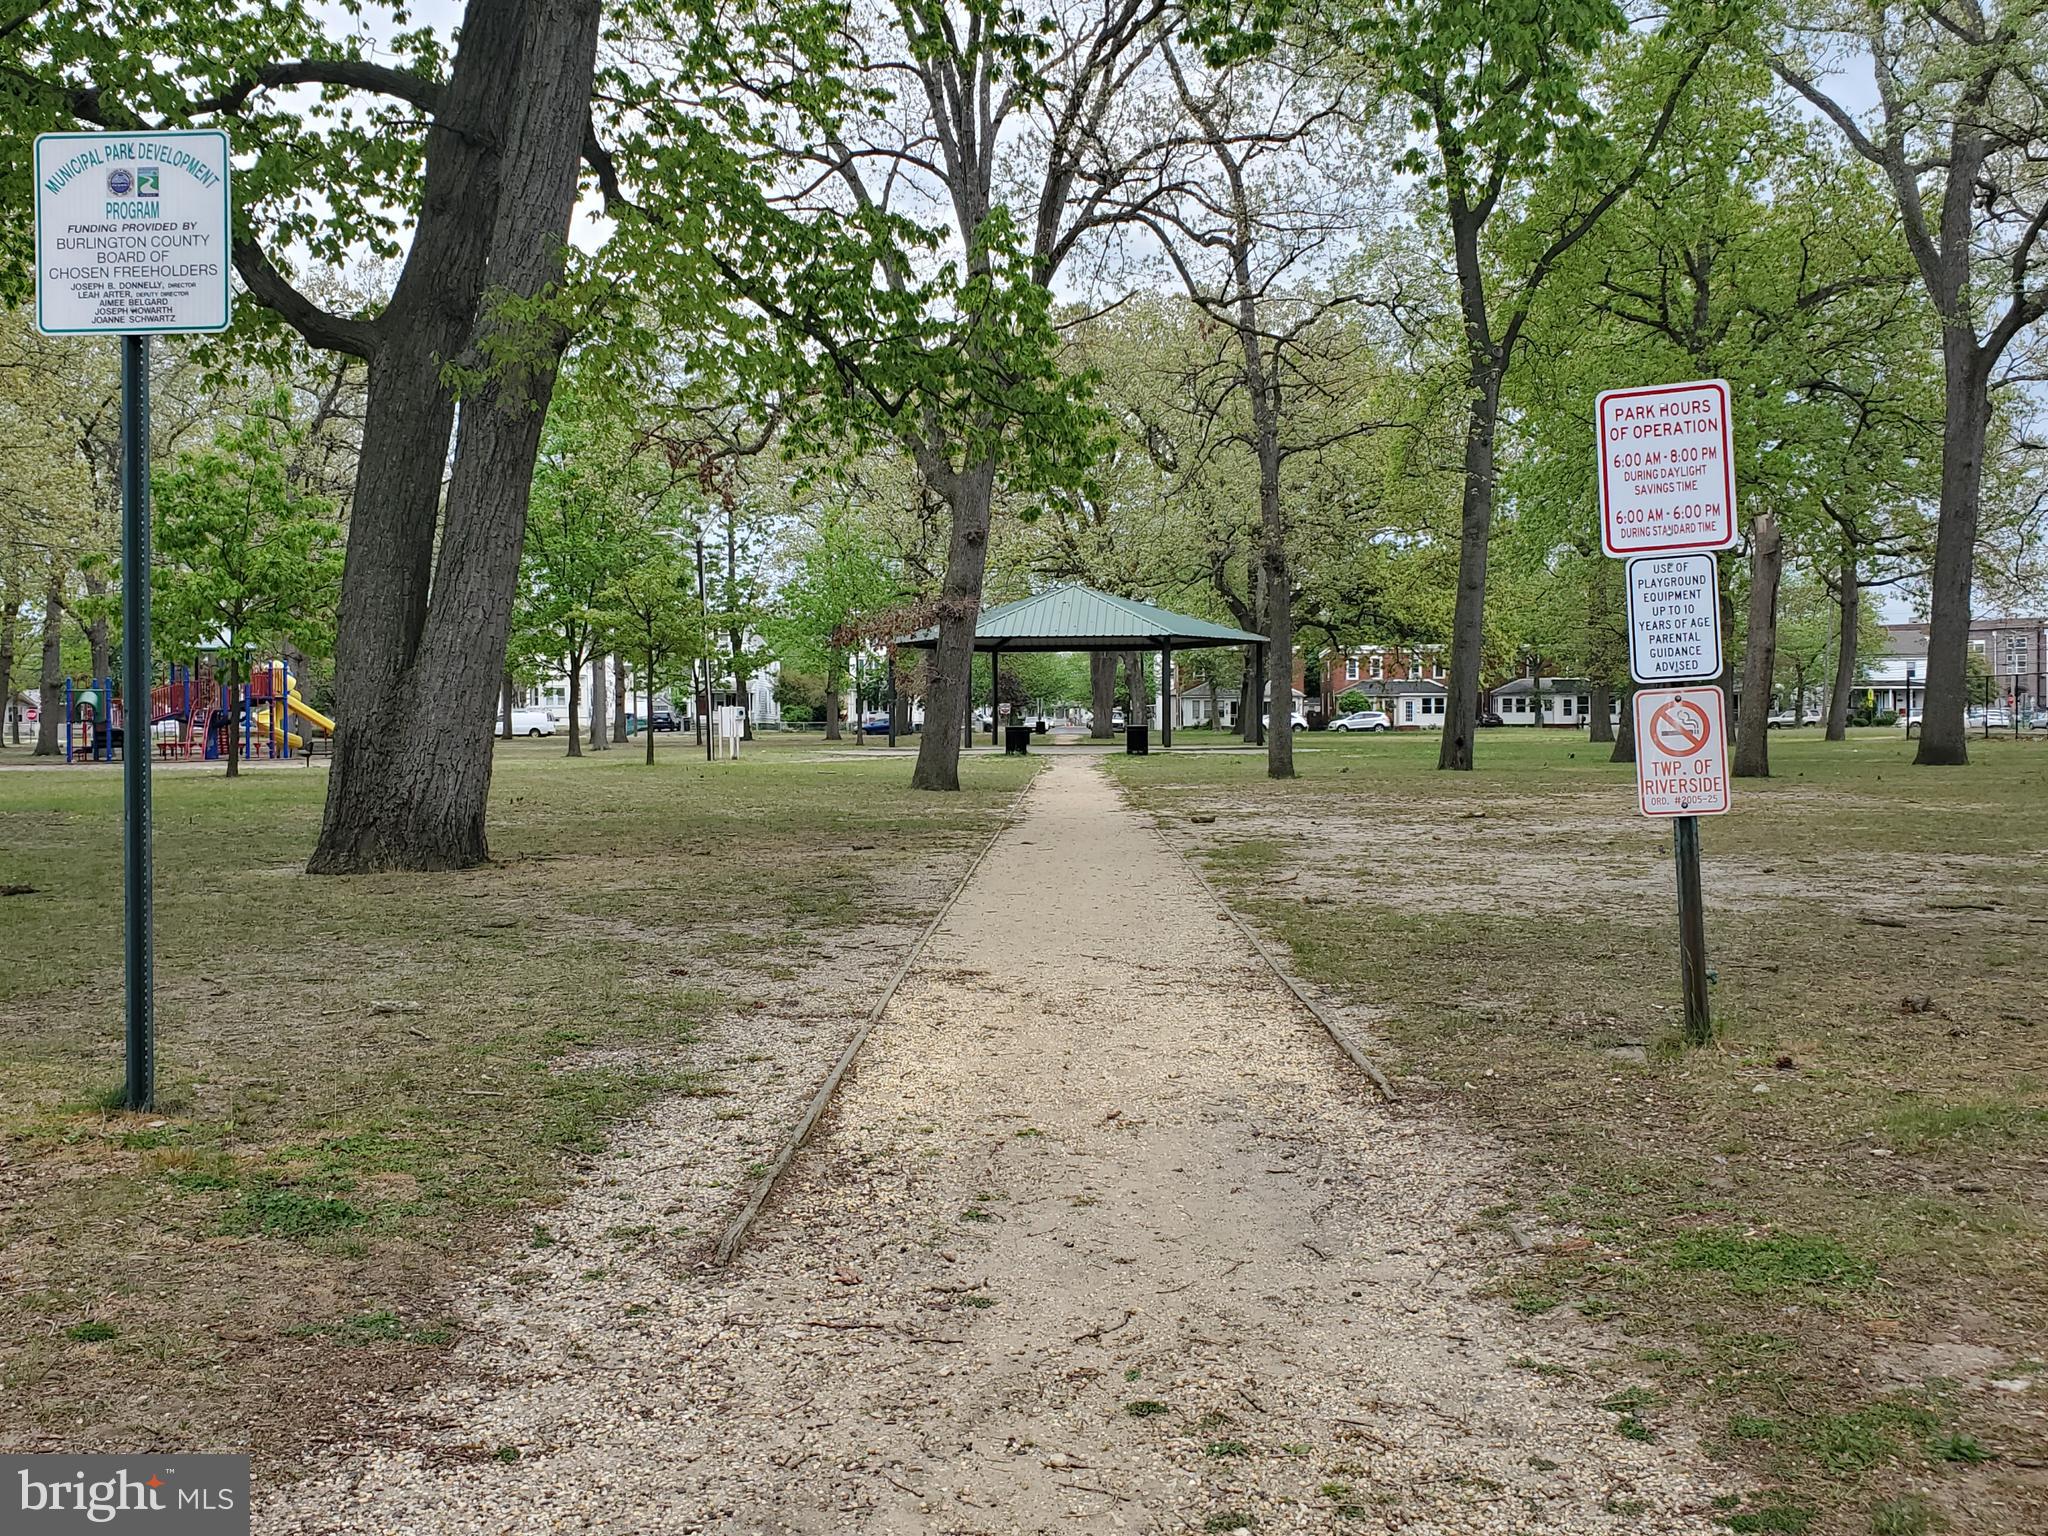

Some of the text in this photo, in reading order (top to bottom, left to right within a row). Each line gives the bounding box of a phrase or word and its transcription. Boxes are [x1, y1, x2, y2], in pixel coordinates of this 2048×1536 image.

[45, 149, 104, 195] MUNICIPAL
[105, 143, 135, 162] PARK
[139, 142, 220, 189] DEVELOPMENT
[106, 201, 159, 220] PROGRAM
[68, 222, 197, 233] FUNDING PROVIDED BY
[57, 235, 210, 249] BURLINGTON COUNTY
[97, 250, 169, 263] BOARD OF
[49, 264, 218, 279] CHOSEN FREEHOLDERS
[70, 282, 104, 291] JOSEPH
[119, 281, 165, 289] DONNELLY,
[78, 291, 100, 299] LEAH
[129, 298, 168, 306] BELGARD
[92, 315, 176, 324] JOANNE SCHWARTZ
[1615, 400, 1711, 422] PARK HOURS
[1610, 418, 1718, 441] OF OPERATION
[1614, 453, 1641, 468] 6:00
[1645, 452, 1660, 465] AM
[1670, 448, 1698, 463] 8:00
[1702, 446, 1717, 460] PM
[1624, 465, 1706, 481] DURING DAYLIGHT
[1635, 480, 1698, 495] SAVINGS TIME
[1616, 509, 1643, 525] 6:00
[1647, 508, 1663, 521] AM
[1673, 504, 1701, 519] 6:00
[1705, 504, 1720, 517] PM
[1621, 521, 1716, 539] DURING STANDARD TIME
[1654, 562, 1688, 574] USE OF
[1638, 575, 1706, 589] PLAYGROUND
[1644, 589, 1701, 602] EQUIPMENT
[1653, 604, 1695, 616] UP TO 10
[1639, 617, 1710, 631] YEARS OF AGE
[1649, 632, 1700, 644] PARENTAL
[1650, 646, 1702, 658] GUIDANCE
[1656, 660, 1698, 672] ADVISED
[1652, 759, 1712, 776] TWP. OF
[1646, 777, 1722, 795] RIVERSIDE
[1651, 795, 1718, 806] ORD. #2005-25
